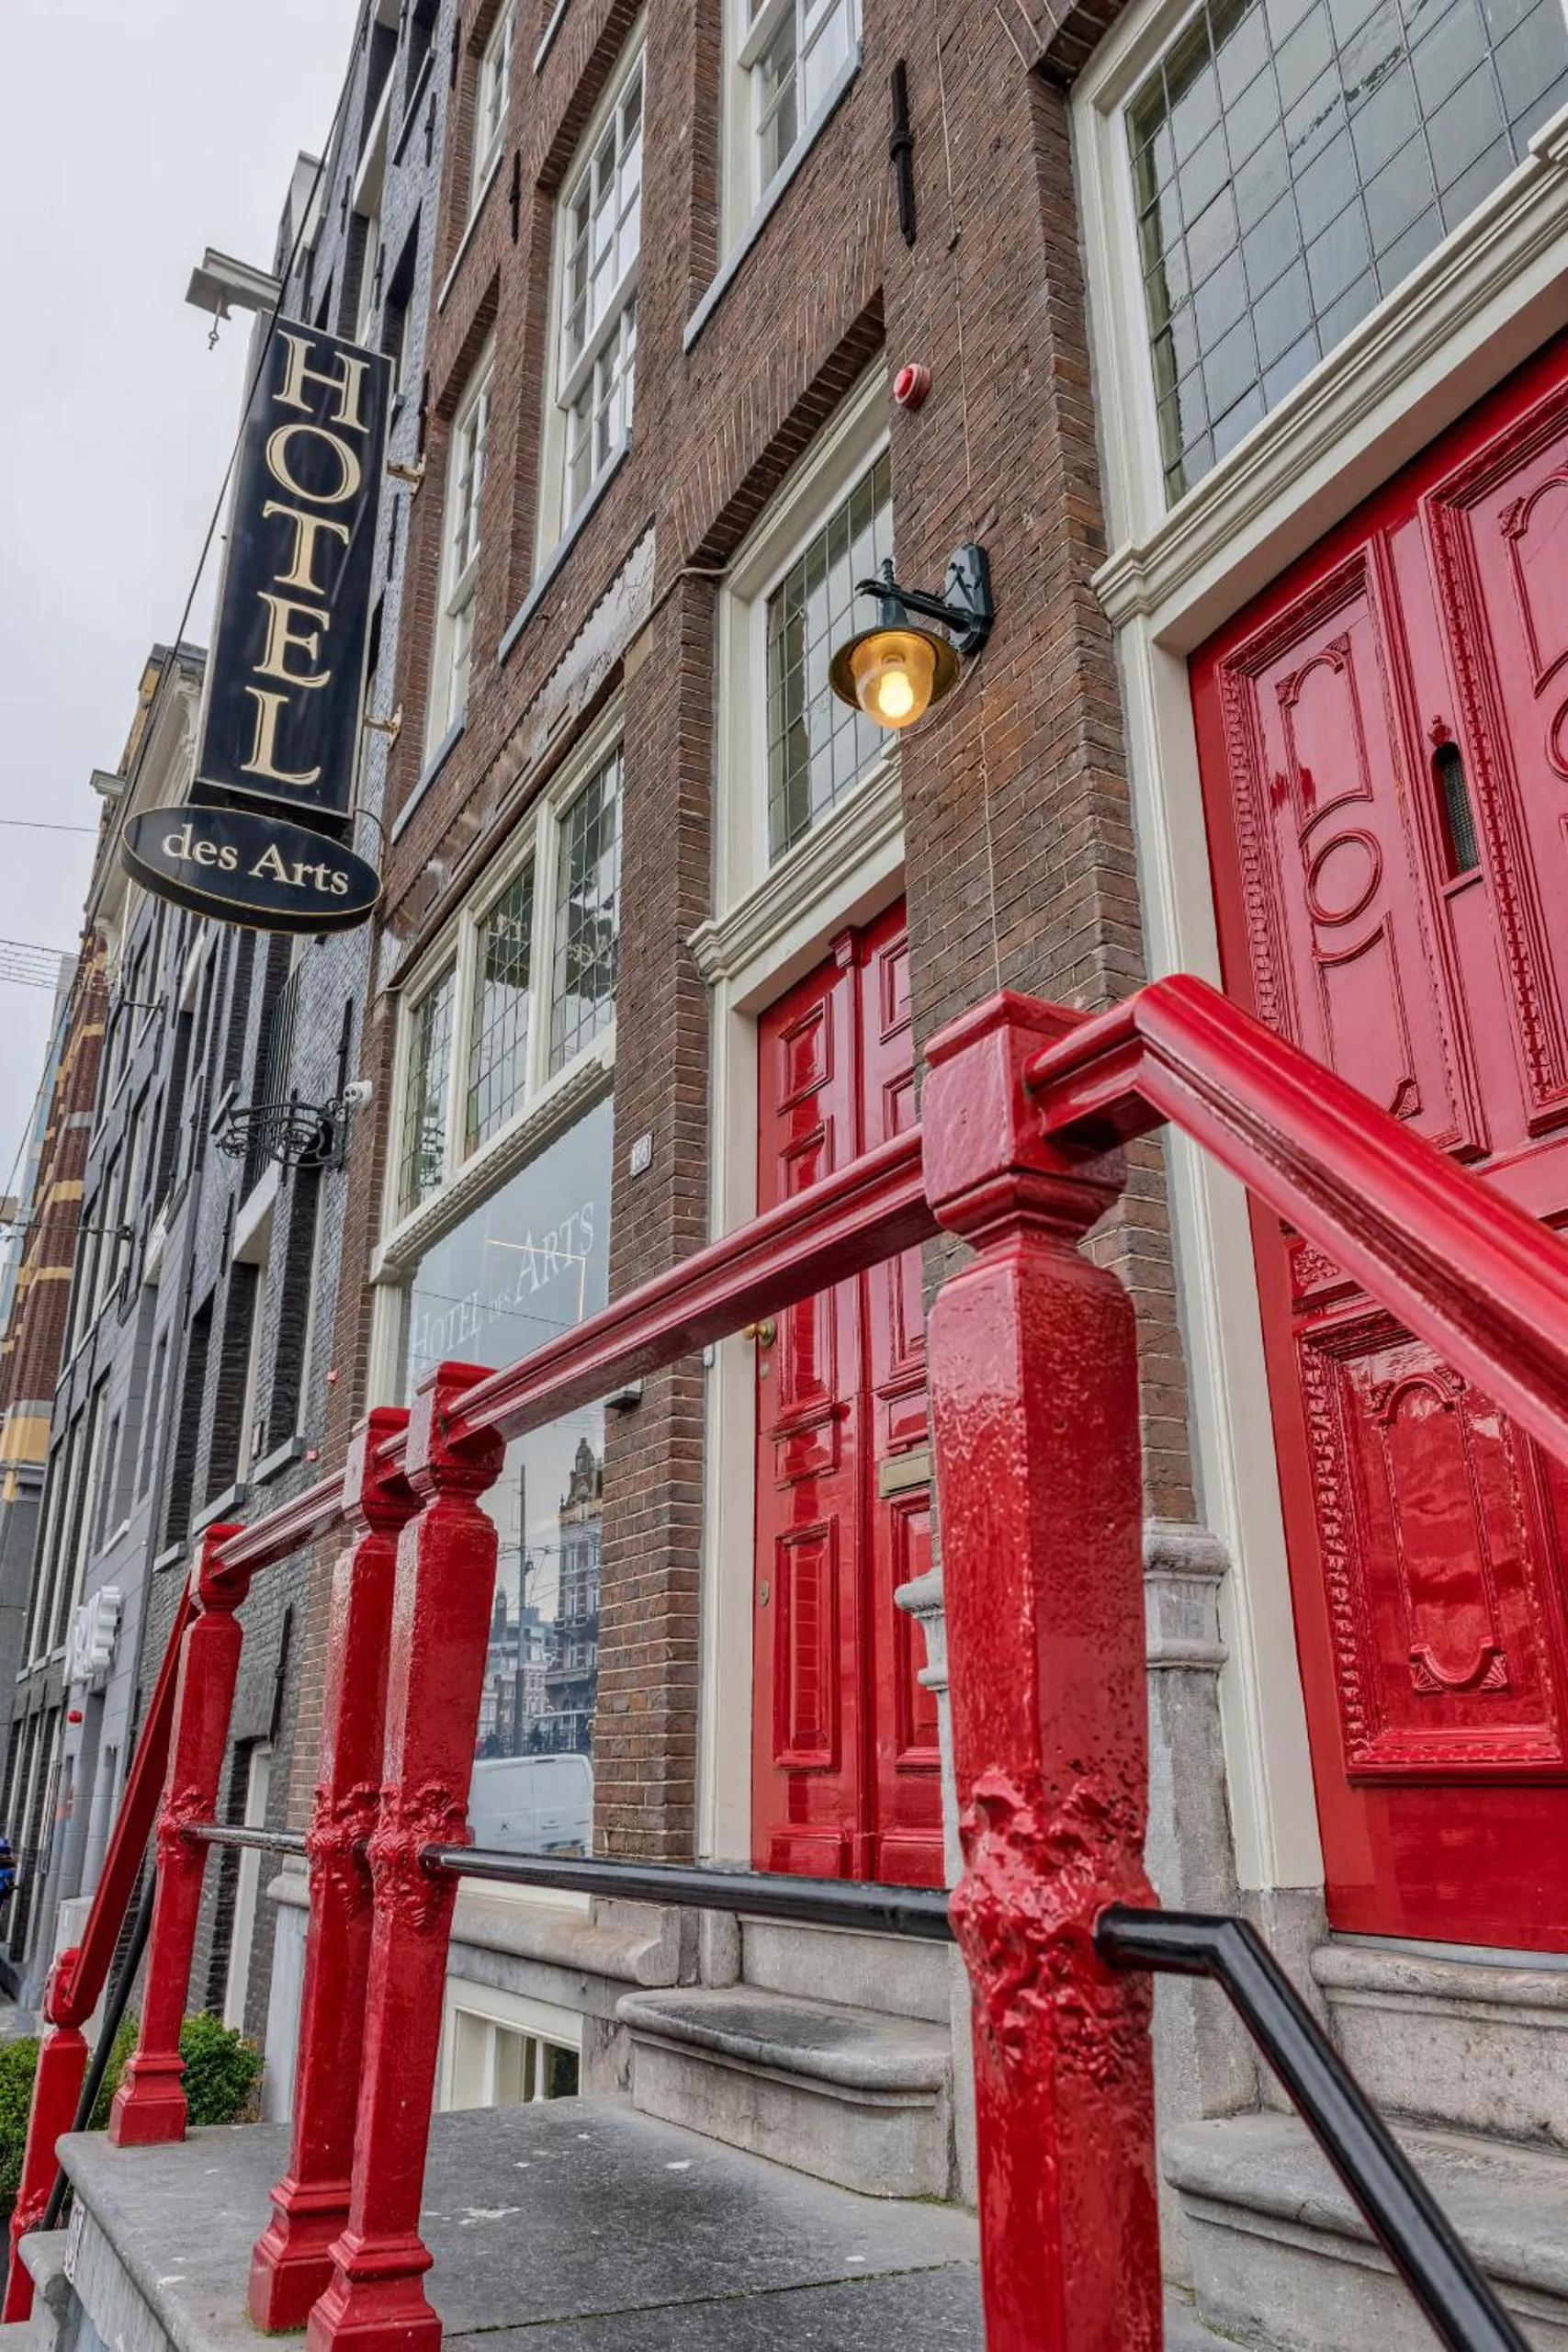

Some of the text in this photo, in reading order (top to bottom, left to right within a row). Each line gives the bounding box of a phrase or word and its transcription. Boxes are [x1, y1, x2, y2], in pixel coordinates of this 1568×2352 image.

[240, 329, 370, 787] HOTEL
[161, 823, 349, 895] des Arts
[513, 1201, 593, 1305] ARTS
